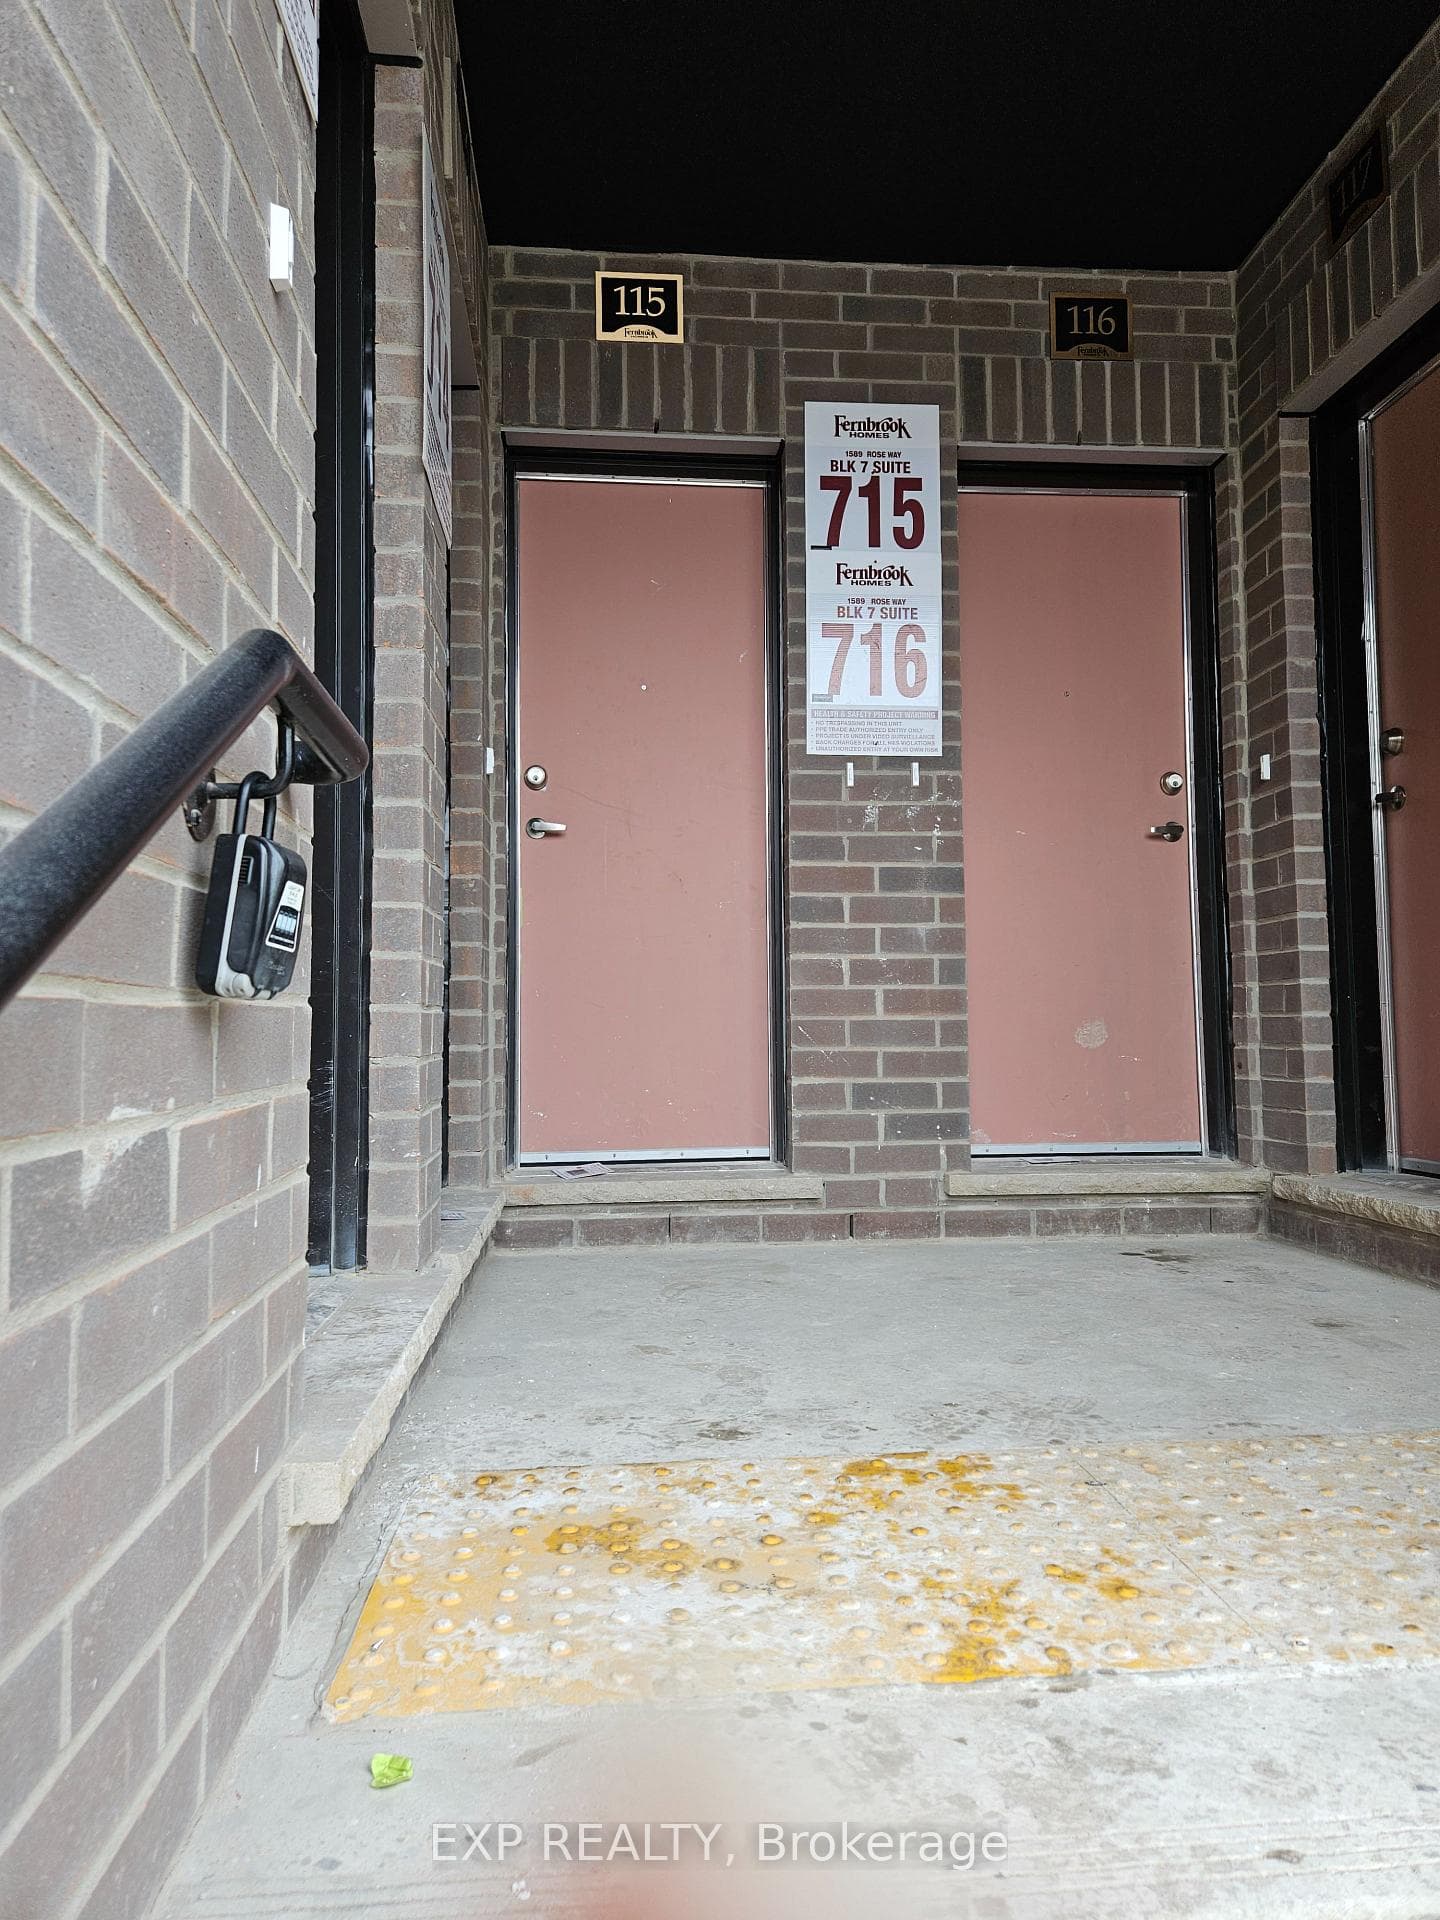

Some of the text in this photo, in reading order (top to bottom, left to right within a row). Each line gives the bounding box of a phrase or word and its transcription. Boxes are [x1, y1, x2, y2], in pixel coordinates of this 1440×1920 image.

[613, 286, 666, 317] 115
[1067, 306, 1116, 335] 116
[834, 415, 912, 438] Fernbrook
[831, 460, 911, 474] BLK 7 SUITE
[820, 475, 925, 549] 715
[836, 563, 914, 586] Fernbrook
[837, 606, 918, 620] BLK 7 SUITE
[822, 623, 928, 698] 716
